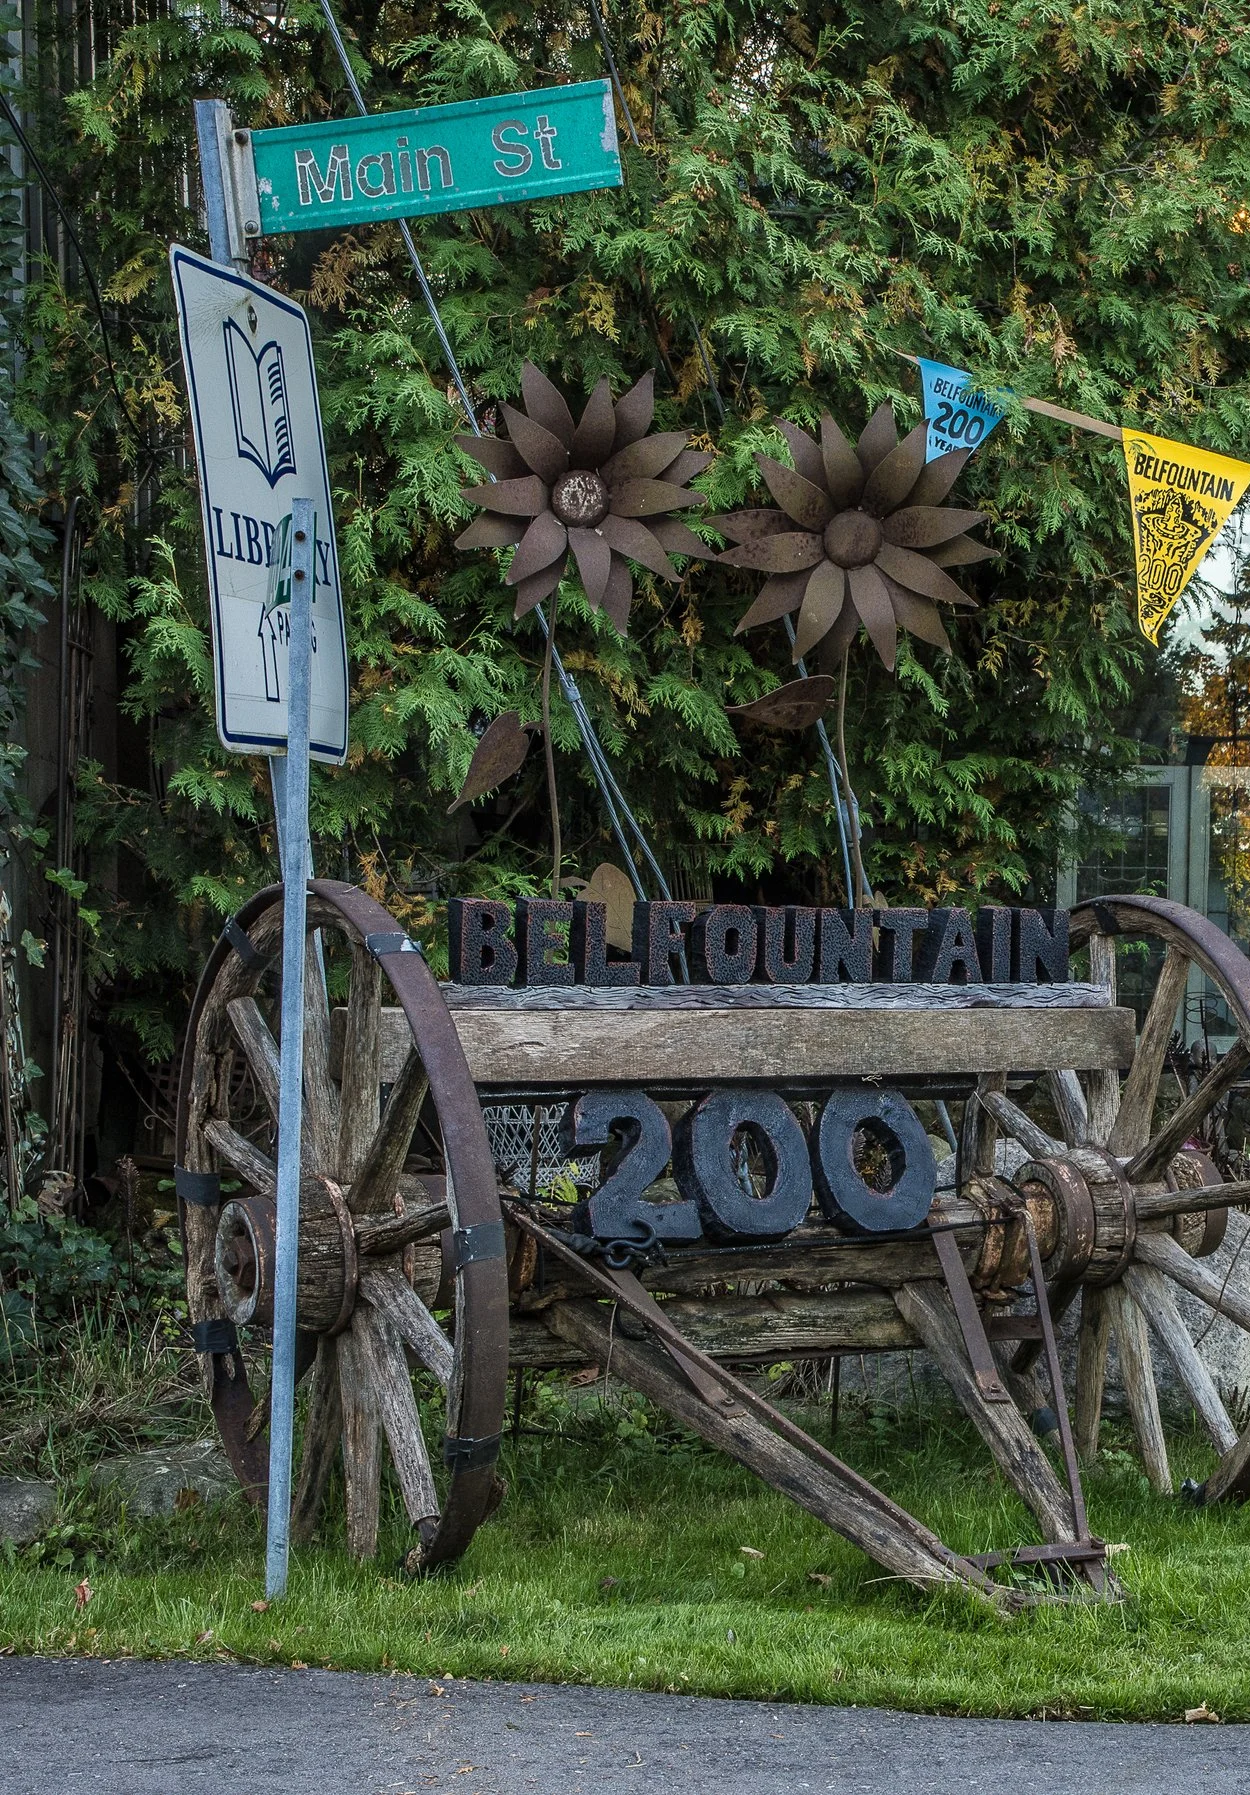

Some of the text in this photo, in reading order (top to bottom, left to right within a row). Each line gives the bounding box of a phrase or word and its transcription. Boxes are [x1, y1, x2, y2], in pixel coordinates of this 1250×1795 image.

[294, 115, 562, 206] Main St
[932, 402, 985, 445] 200
[1134, 453, 1236, 502] BELFOUNTAIN
[212, 506, 331, 586] LIBRY
[1138, 553, 1184, 597] 200
[448, 898, 1069, 986] BELFOUNTAIN
[558, 1090, 936, 1243] 200
